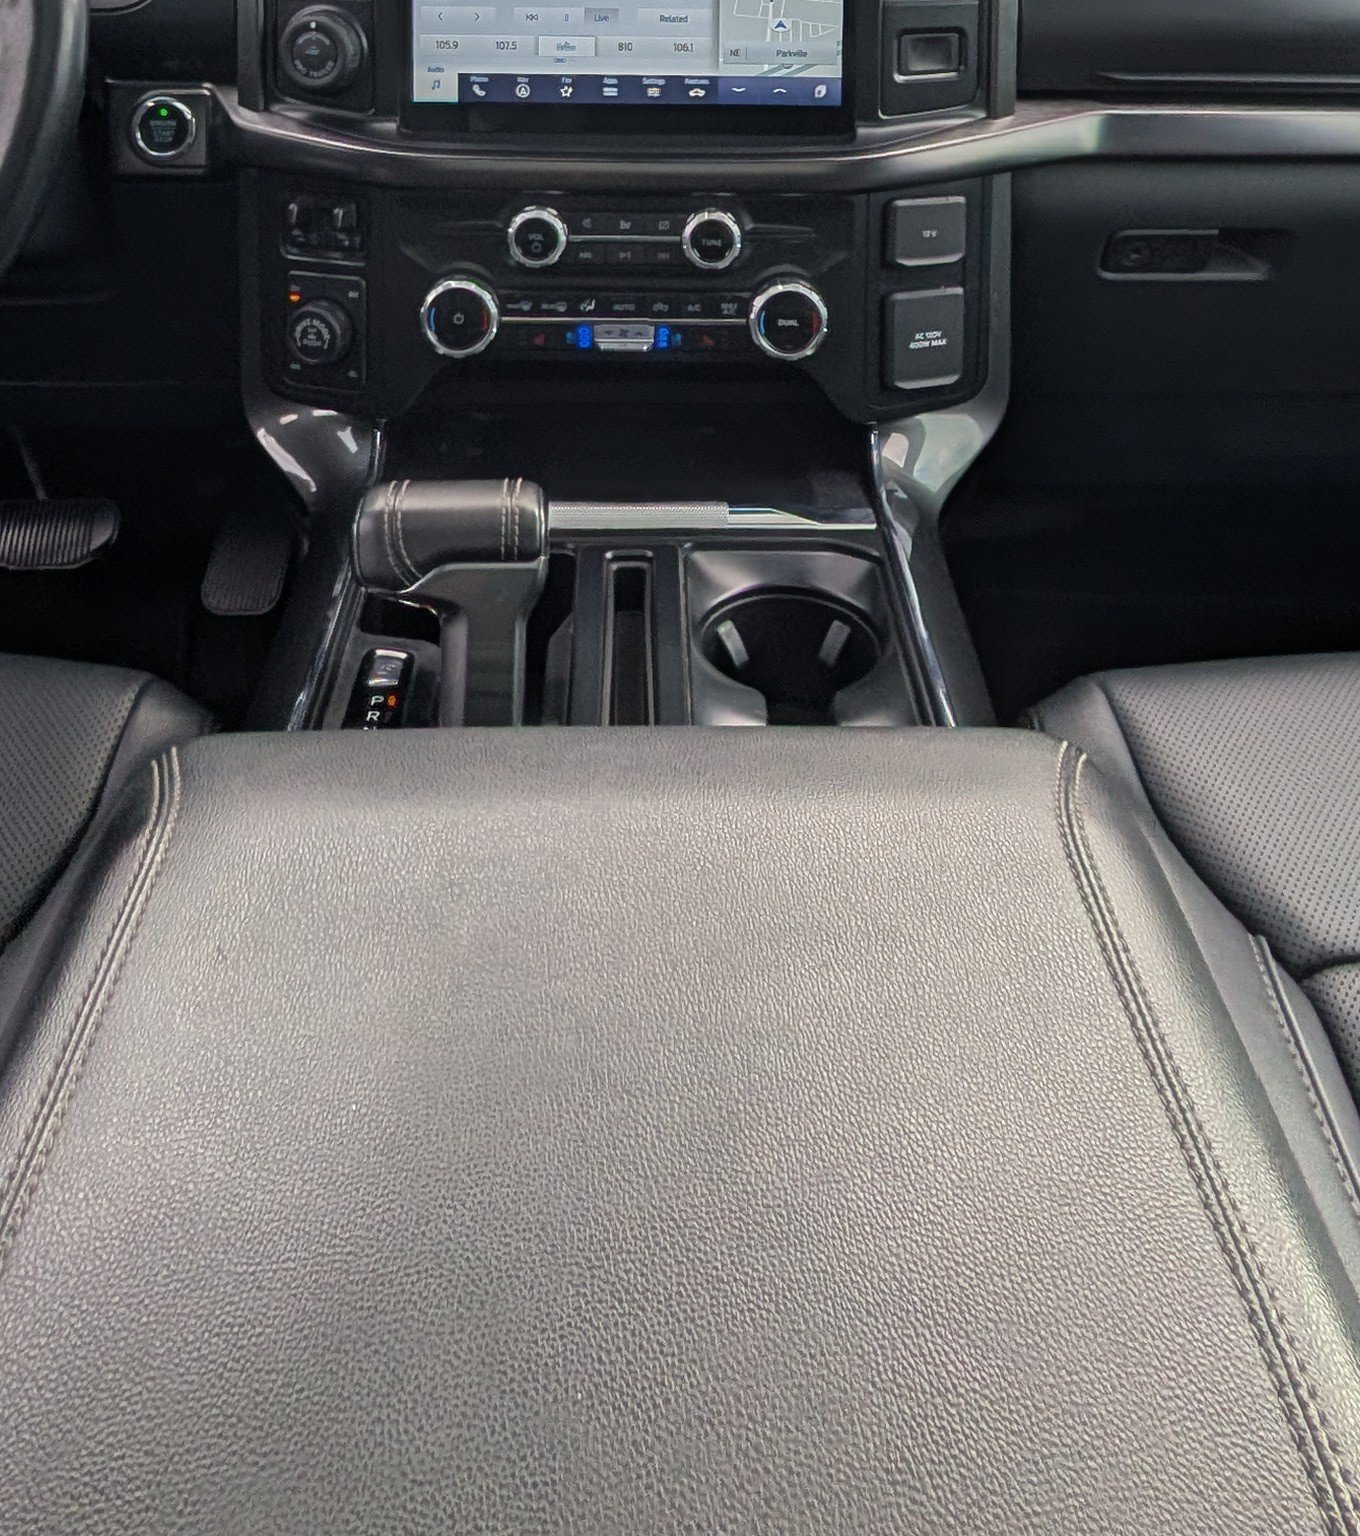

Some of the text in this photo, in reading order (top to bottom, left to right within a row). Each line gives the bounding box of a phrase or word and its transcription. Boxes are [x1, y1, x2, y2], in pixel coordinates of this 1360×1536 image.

[594, 14, 610, 22] Live
[659, 15, 688, 23] Related
[435, 41, 459, 50] 105.9
[495, 41, 517, 50] 107.5
[618, 42, 633, 52] 810
[776, 49, 808, 58] Parkville
[931, 339, 947, 347] MAX
[371, 695, 385, 706] P
[366, 710, 380, 722] R
